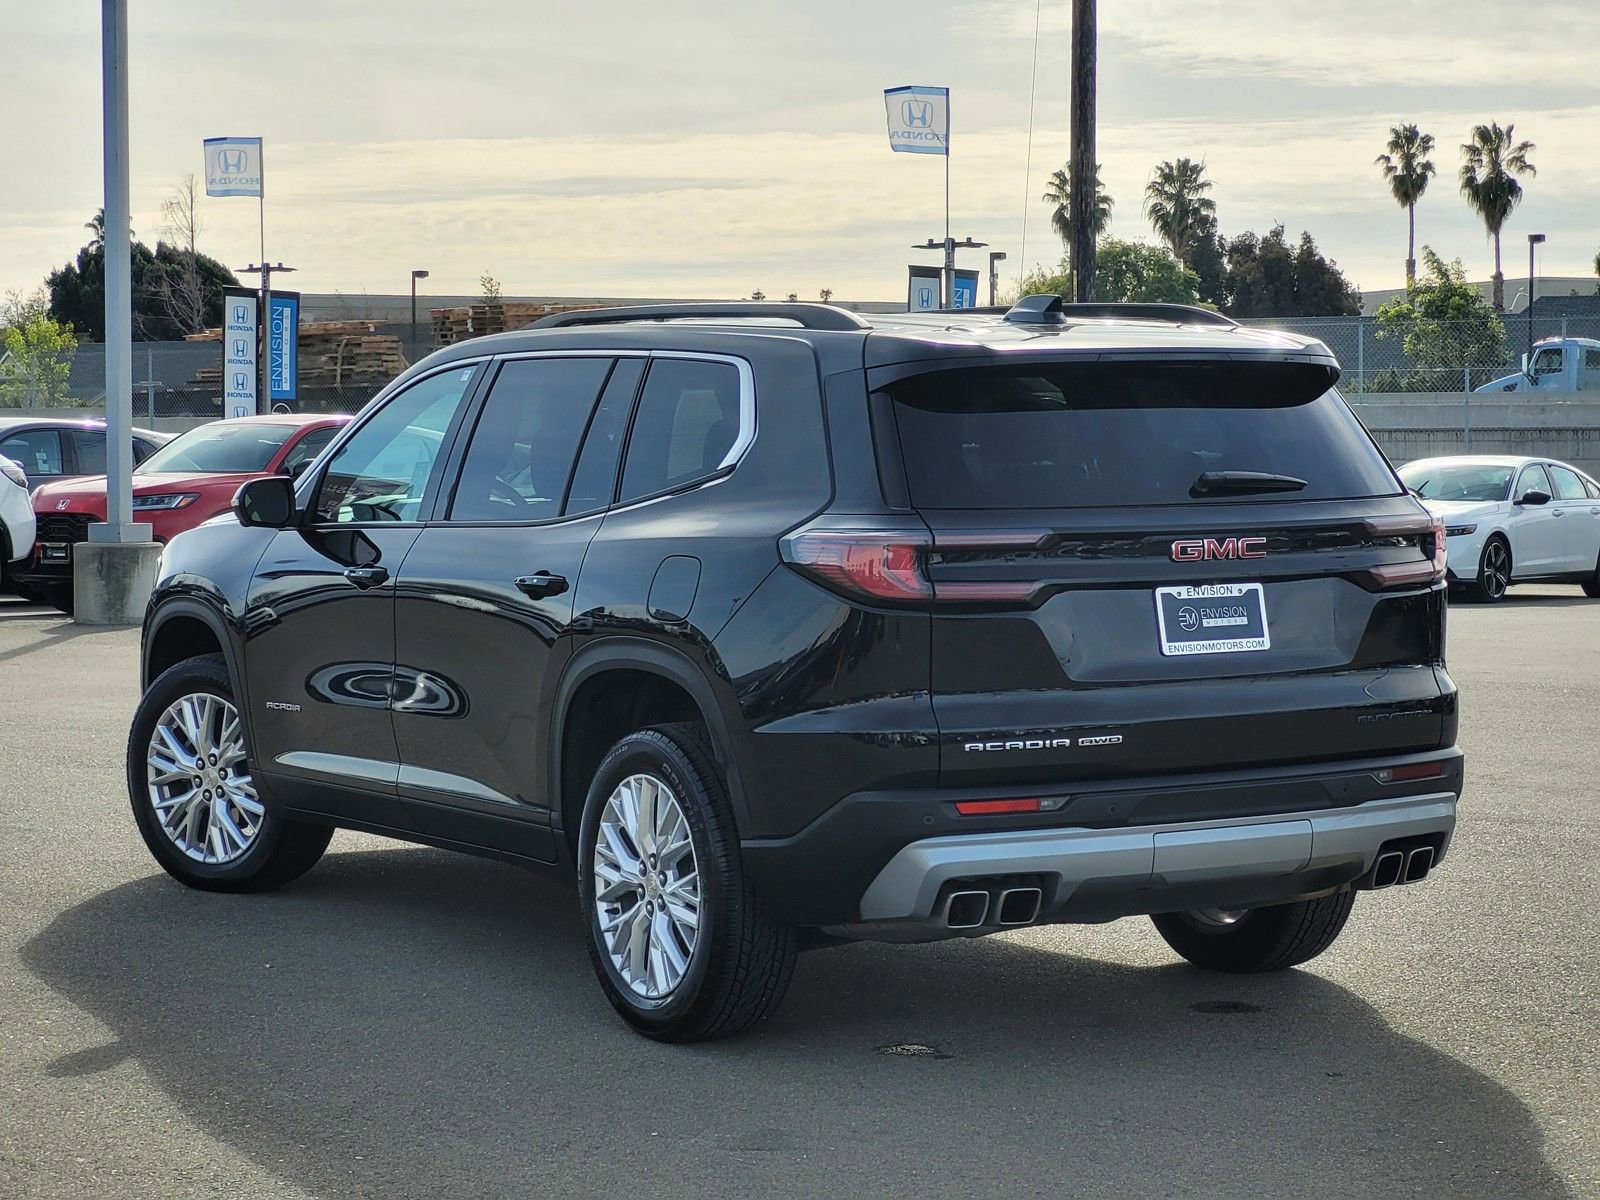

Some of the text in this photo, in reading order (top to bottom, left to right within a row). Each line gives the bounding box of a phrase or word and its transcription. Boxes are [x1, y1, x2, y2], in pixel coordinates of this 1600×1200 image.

[271, 306, 283, 391] ENVISION
[227, 358, 254, 366] HONDA
[1171, 537, 1266, 562] GMC
[1186, 586, 1233, 597] ENVISION
[1200, 606, 1247, 619] ENVISION
[1168, 640, 1265, 653] ENVISIONMOTORS.COM
[266, 701, 301, 712] ACADIA
[964, 736, 1122, 752] ACADIA AWD
